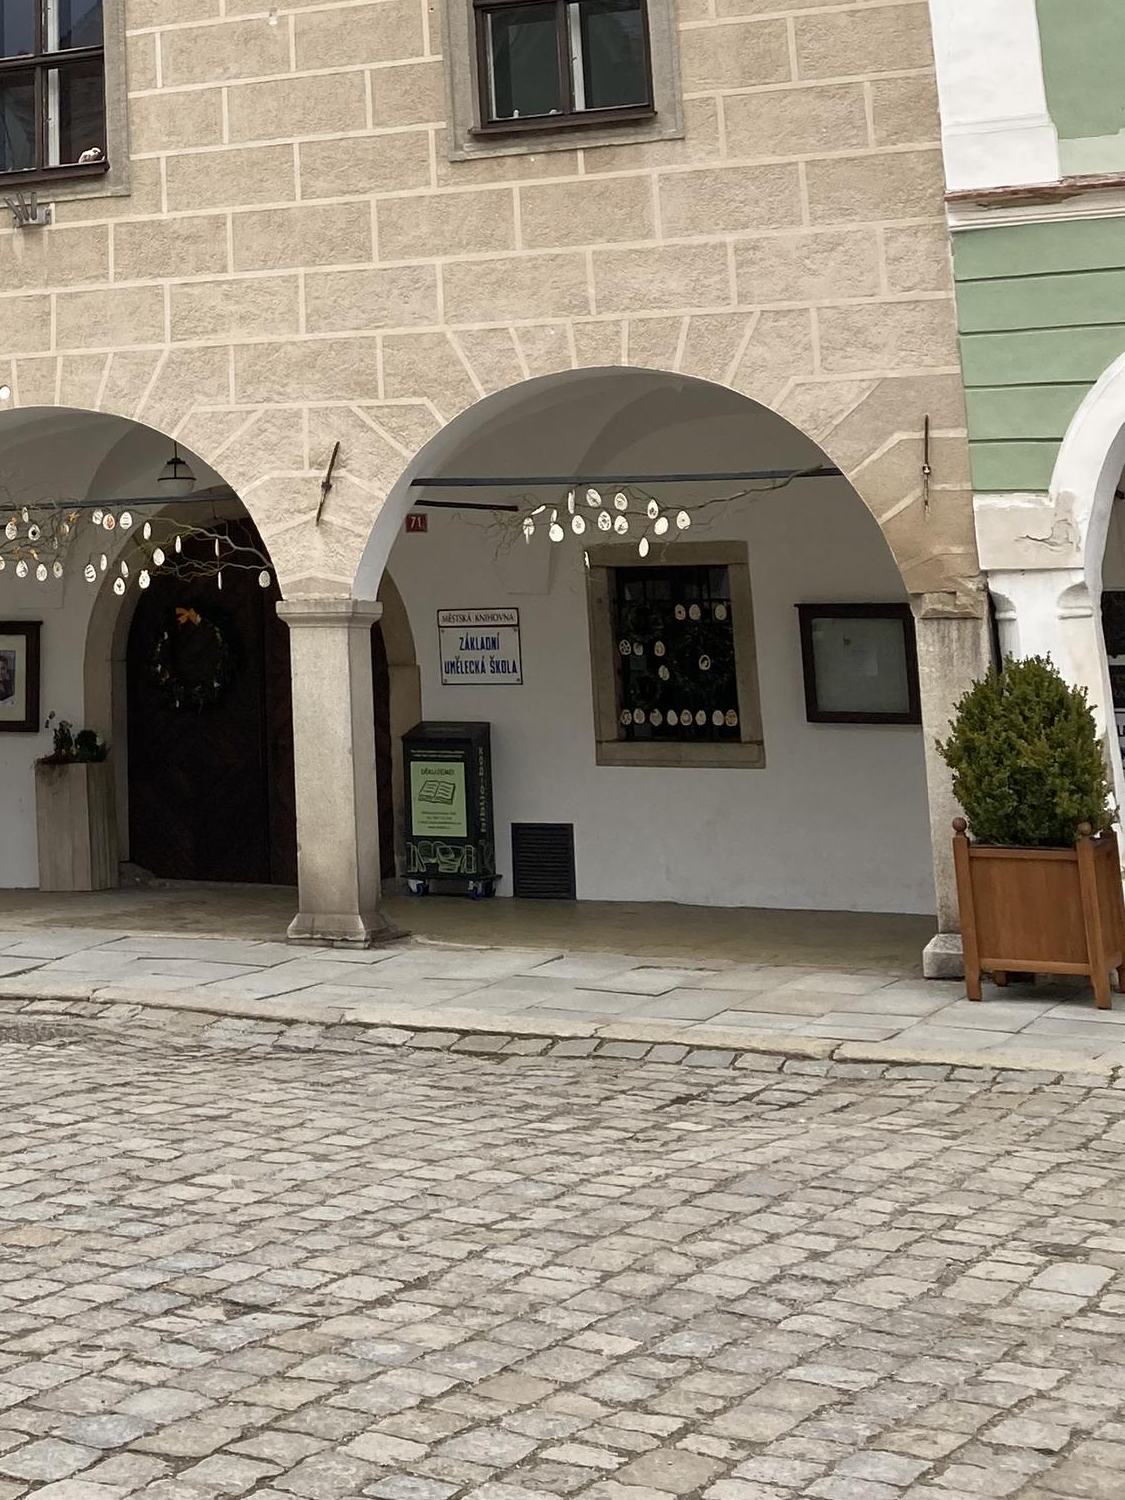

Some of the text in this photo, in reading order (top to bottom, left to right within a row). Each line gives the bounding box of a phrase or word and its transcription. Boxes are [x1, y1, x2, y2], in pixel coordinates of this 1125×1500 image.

[410, 516, 422, 528] 71
[441, 612, 515, 622] MĚSTSKÁ KNIHOVNA
[459, 632, 500, 651] ZÁKLADNÍ
[444, 655, 518, 674] UMĚLECKÁ ŠKOLA
